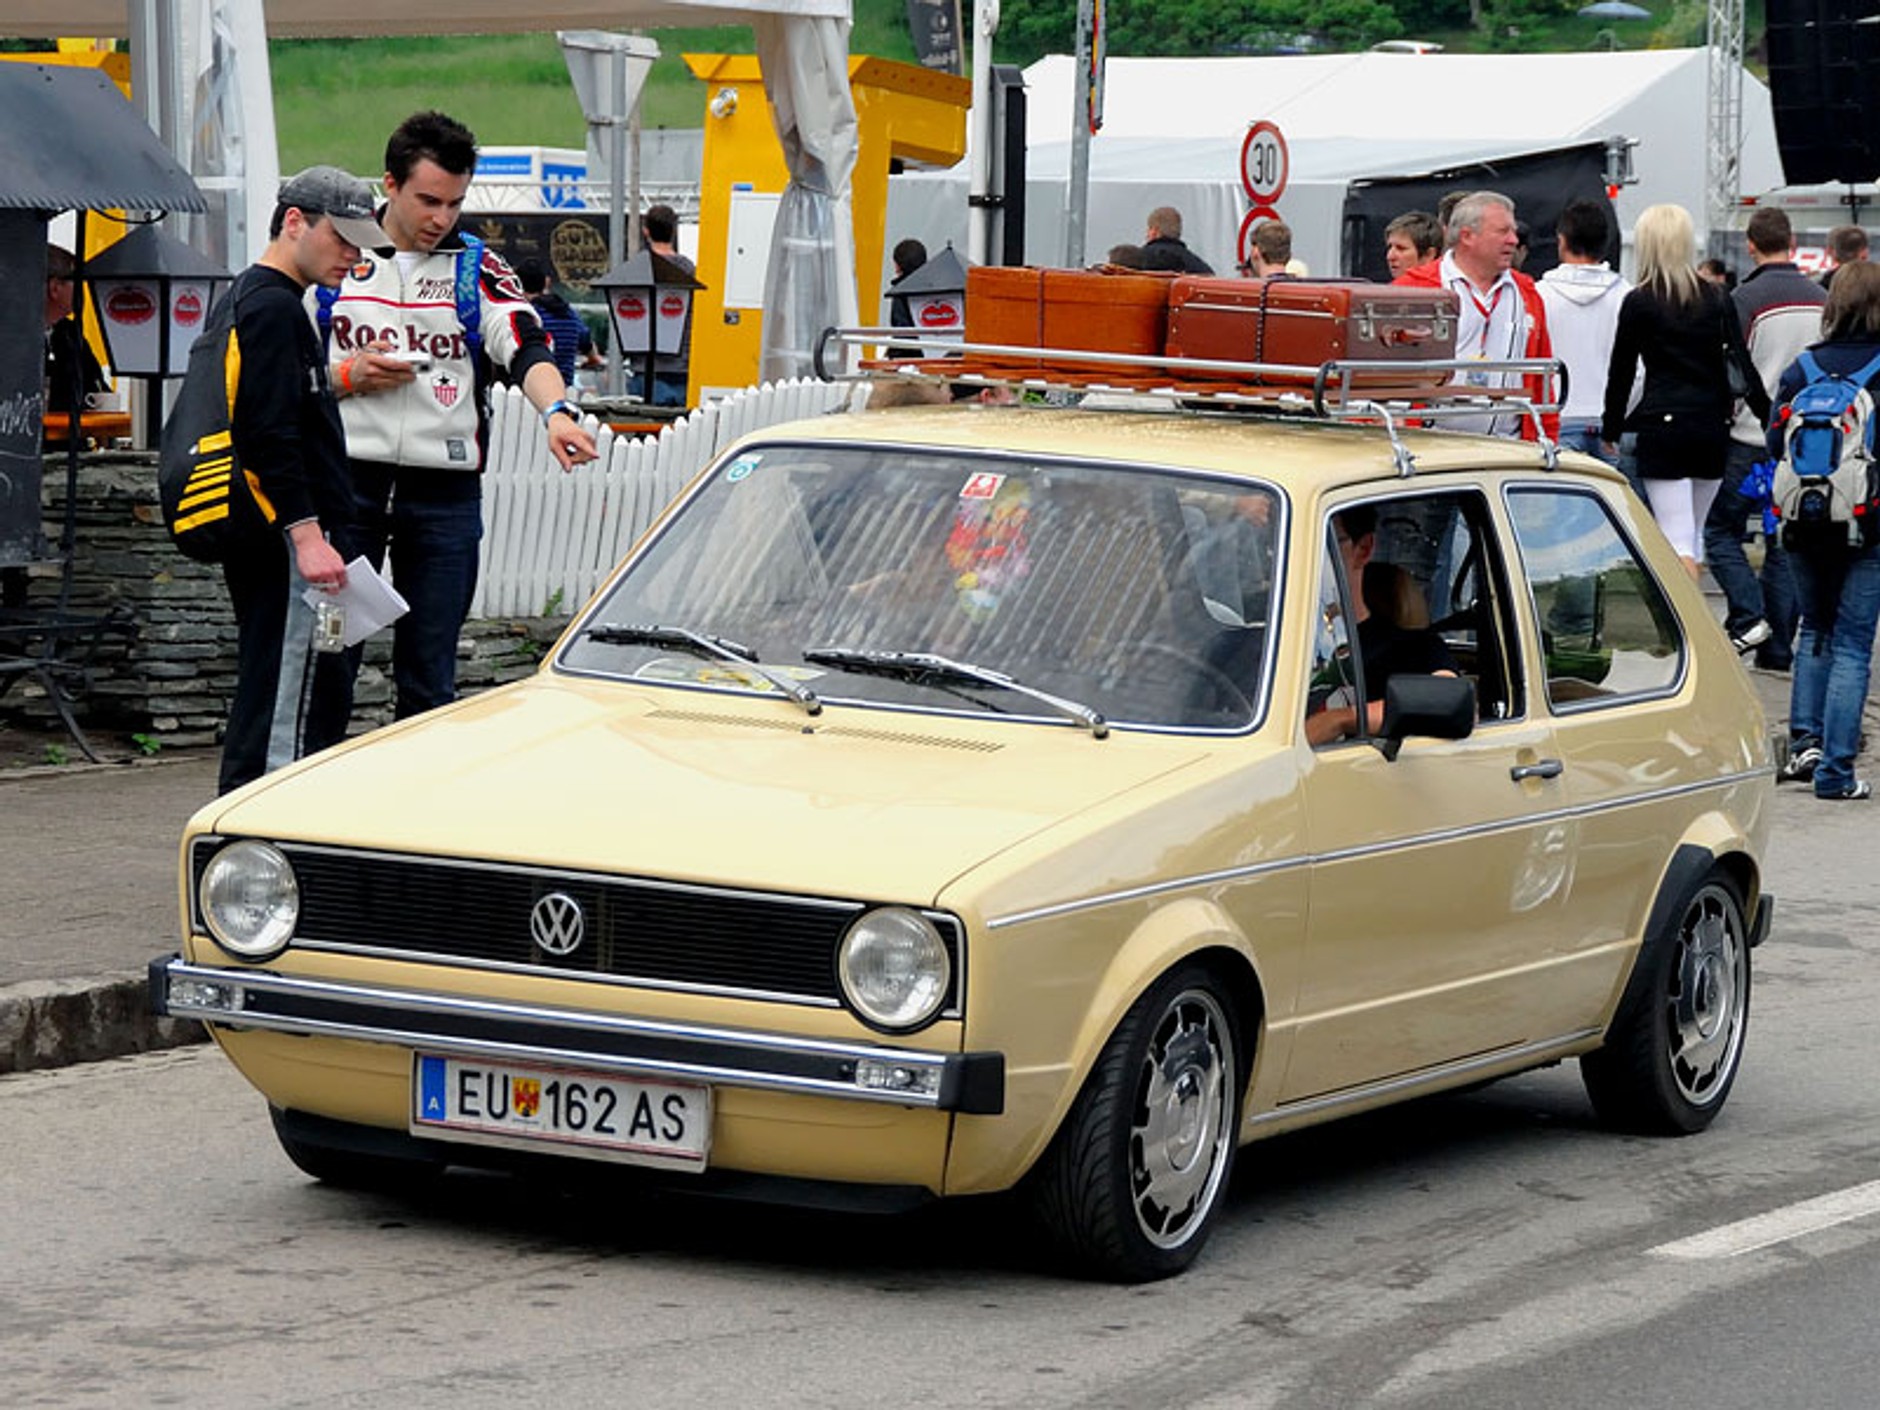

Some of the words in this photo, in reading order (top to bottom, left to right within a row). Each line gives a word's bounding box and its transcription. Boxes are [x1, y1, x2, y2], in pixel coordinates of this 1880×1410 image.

[1252, 142, 1277, 187] 30
[531, 893, 584, 956] VW
[428, 1096, 441, 1111] A
[458, 1069, 509, 1120] EU
[545, 1080, 618, 1131] 162
[629, 1090, 686, 1142] AS
